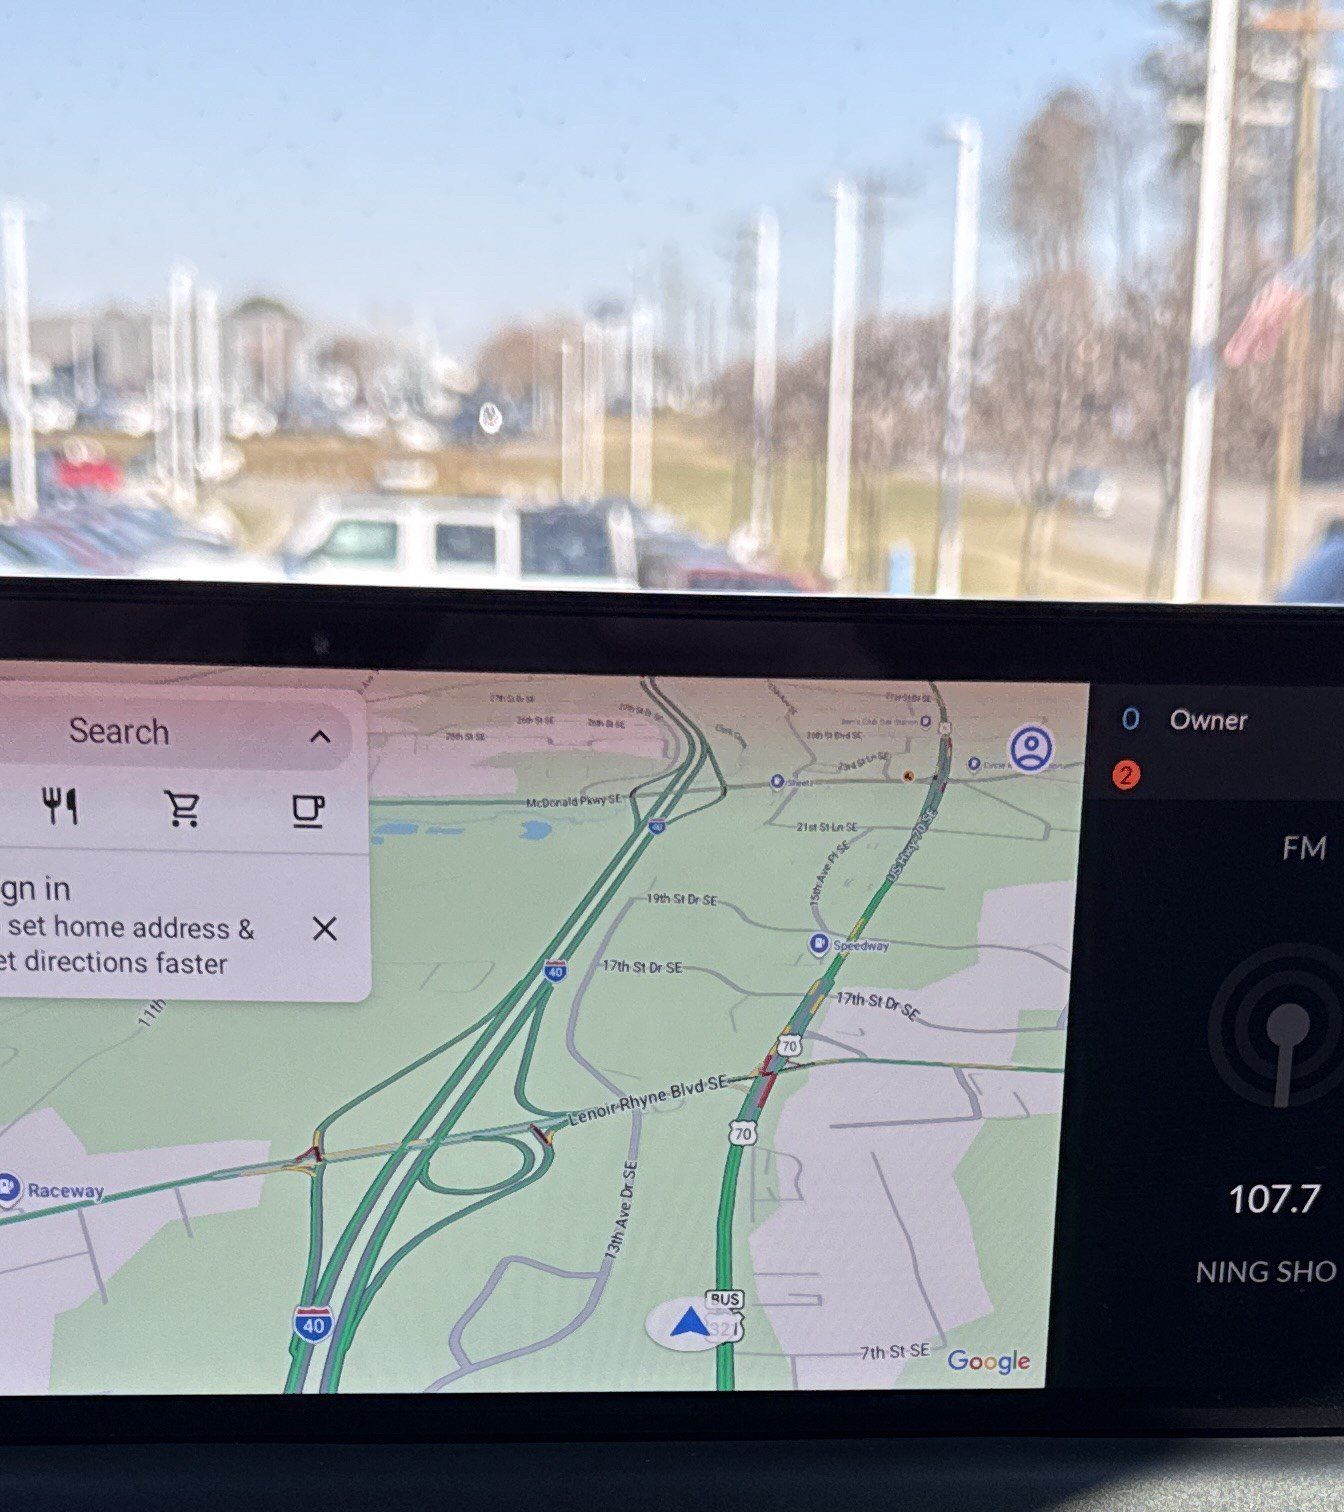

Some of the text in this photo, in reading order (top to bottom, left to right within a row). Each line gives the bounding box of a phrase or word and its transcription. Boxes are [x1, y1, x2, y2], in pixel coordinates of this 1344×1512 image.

[69, 716, 171, 747] Search
[1170, 708, 1249, 732] Owner
[526, 797, 579, 809] McDonald
[845, 822, 858, 832] SE
[1282, 835, 1328, 861] FM
[45, 875, 72, 902] in
[646, 893, 671, 905] 19th
[673, 894, 687, 905] St
[703, 895, 718, 907] SE
[8, 917, 47, 937] set
[54, 916, 125, 939] home
[132, 917, 231, 940] address
[238, 918, 256, 941] &
[833, 940, 889, 953] Speedway
[25, 950, 149, 975] directions
[156, 951, 229, 976] faster
[603, 959, 684, 974] 17th St Dr SE
[837, 991, 922, 1022] 17th St Dr SE
[782, 1040, 798, 1053] 70
[568, 1073, 729, 1126] Lenoir Rhyne Blvd SE
[735, 1127, 752, 1141] 70
[27, 1182, 105, 1201] Raceway
[1228, 1183, 1322, 1215] 107.7
[605, 1160, 638, 1259] 13th Ave Dr SE
[1195, 1259, 1339, 1285] NING SHO
[711, 1293, 740, 1307] BUS
[302, 1316, 326, 1335] 40
[860, 1342, 931, 1361] 7th St SE
[947, 1349, 1031, 1376] Google
